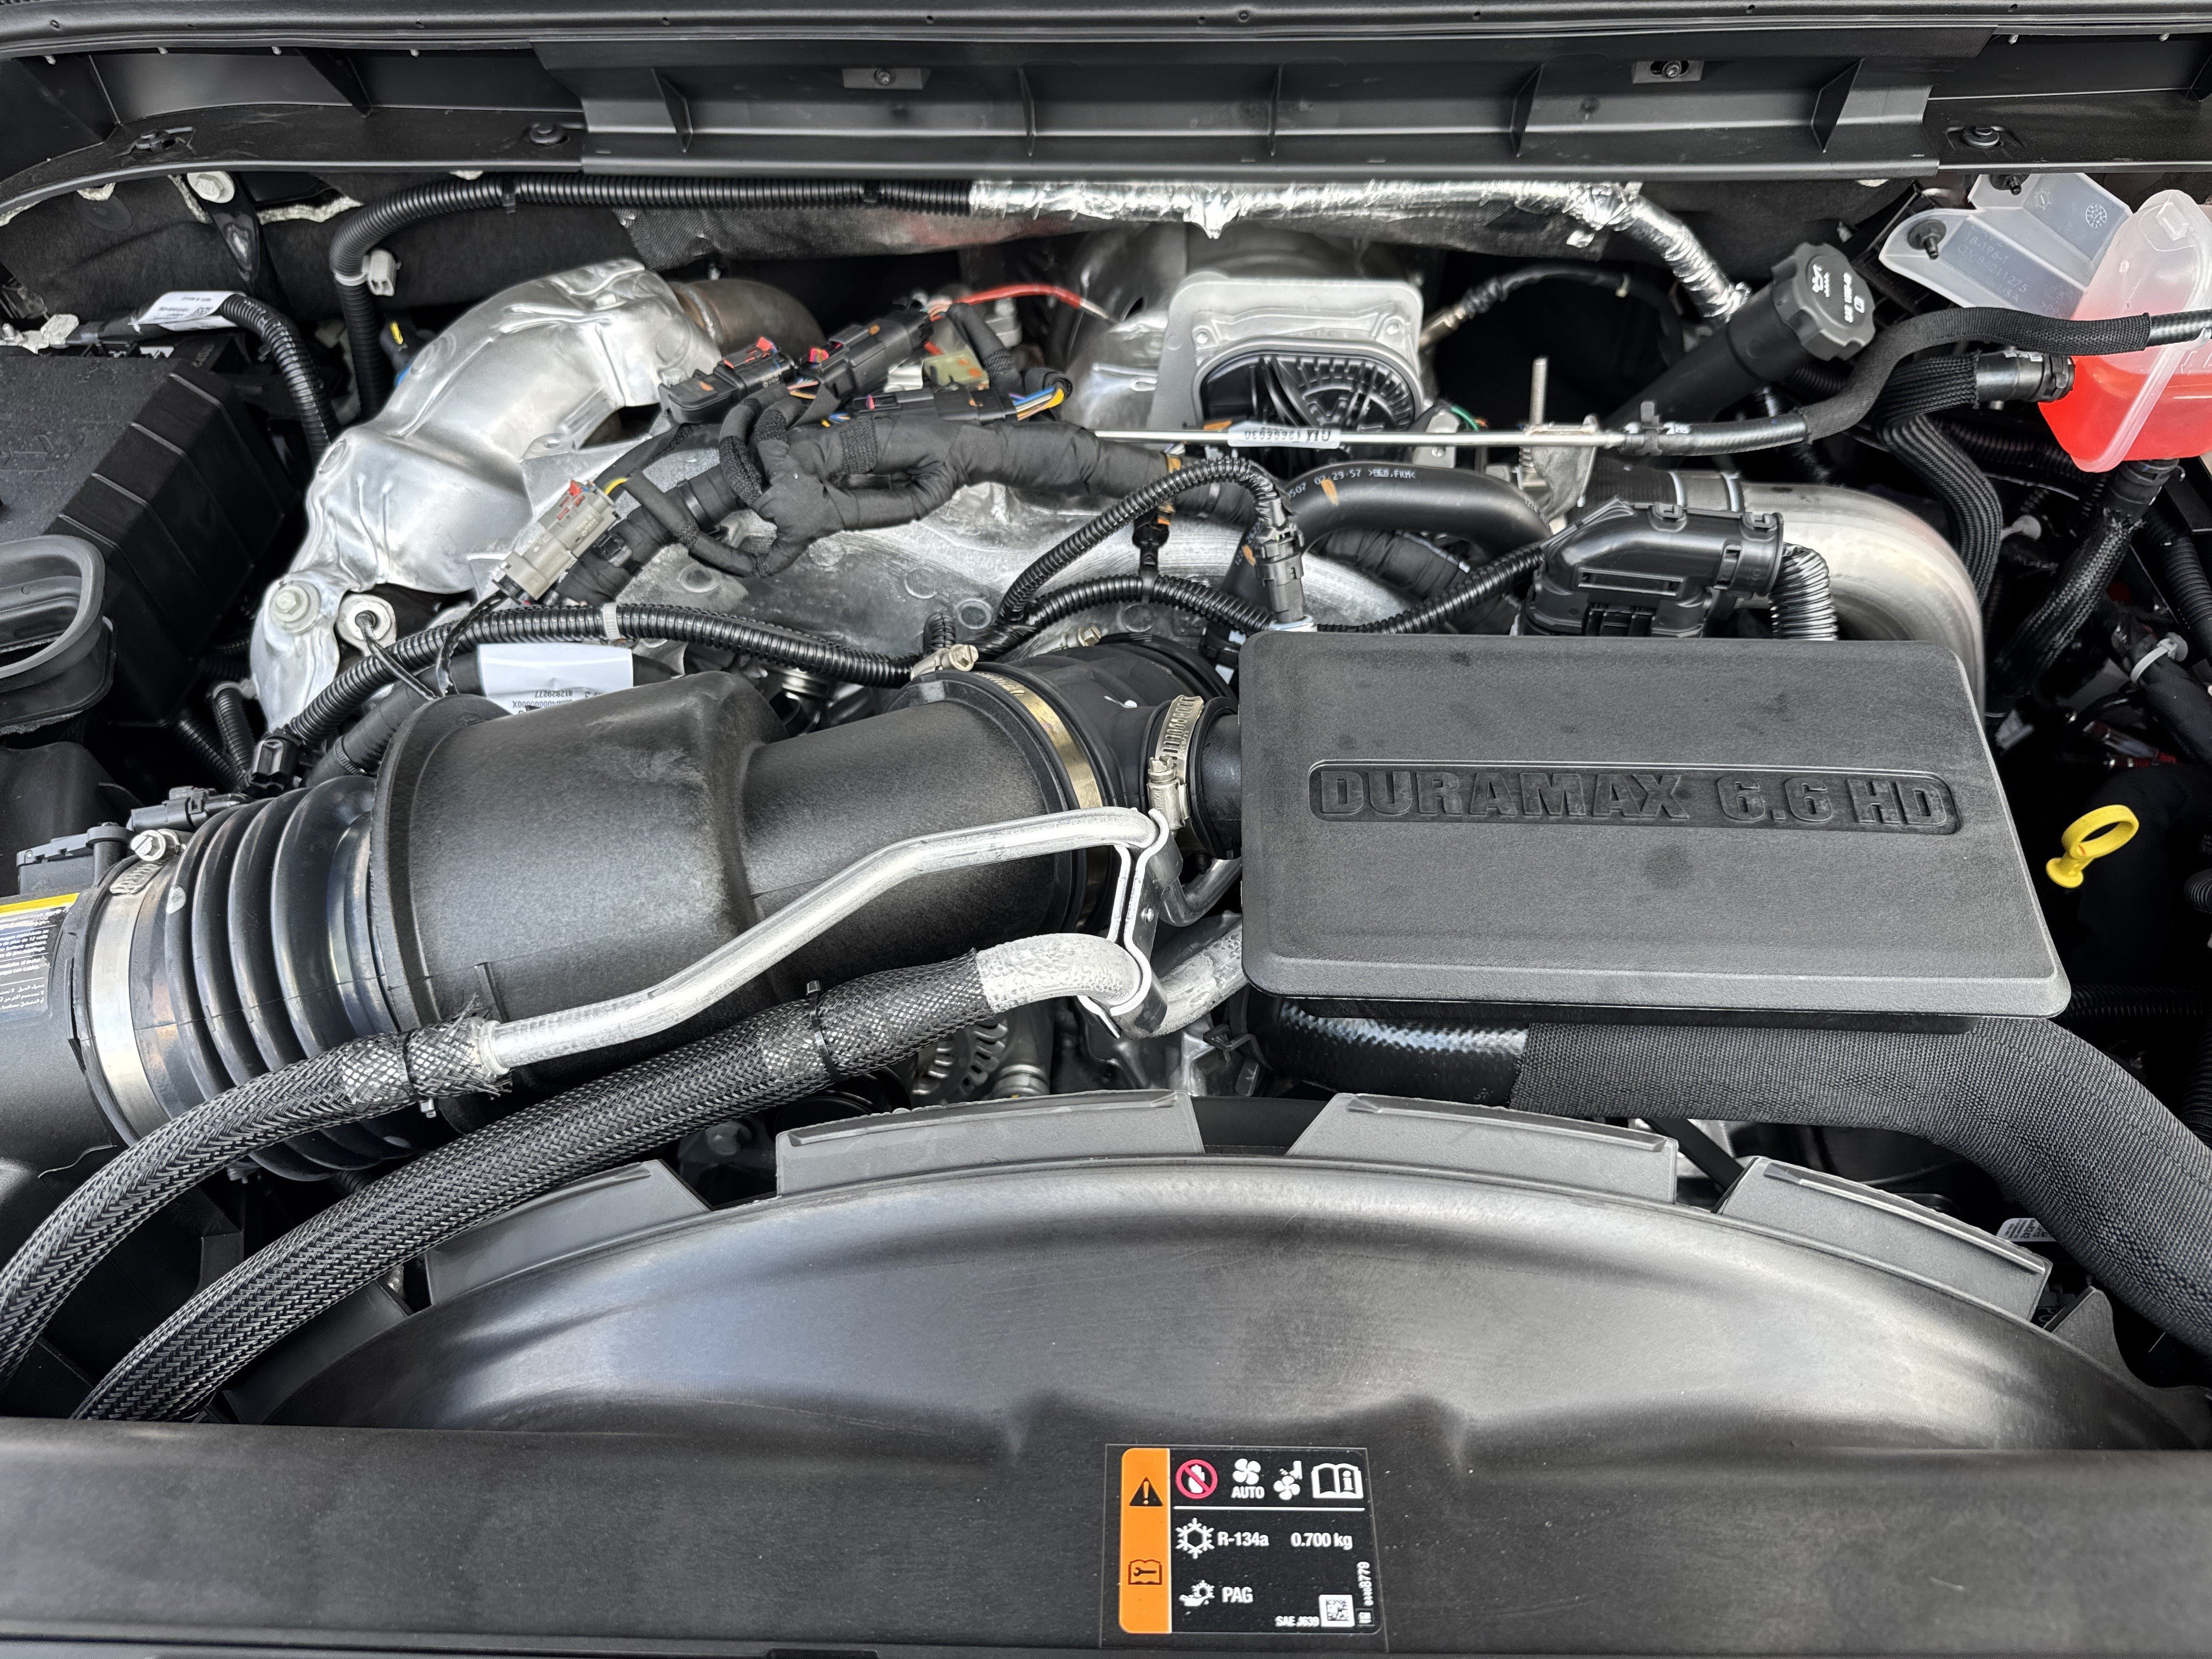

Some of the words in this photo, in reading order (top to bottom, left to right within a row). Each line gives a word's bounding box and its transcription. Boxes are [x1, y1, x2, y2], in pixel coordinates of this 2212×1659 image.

[1320, 770, 1690, 820] DURAMAX
[1717, 775, 1834, 823] 6.6
[1846, 777, 1948, 828] HD
[1231, 1486, 1265, 1499] AUTO
[1217, 1531, 1270, 1547] R-134a
[1290, 1532, 1332, 1548] 0.700
[1333, 1532, 1353, 1550] kg
[1221, 1586, 1254, 1604] PAG
[1274, 1615, 1296, 1628] SAE
